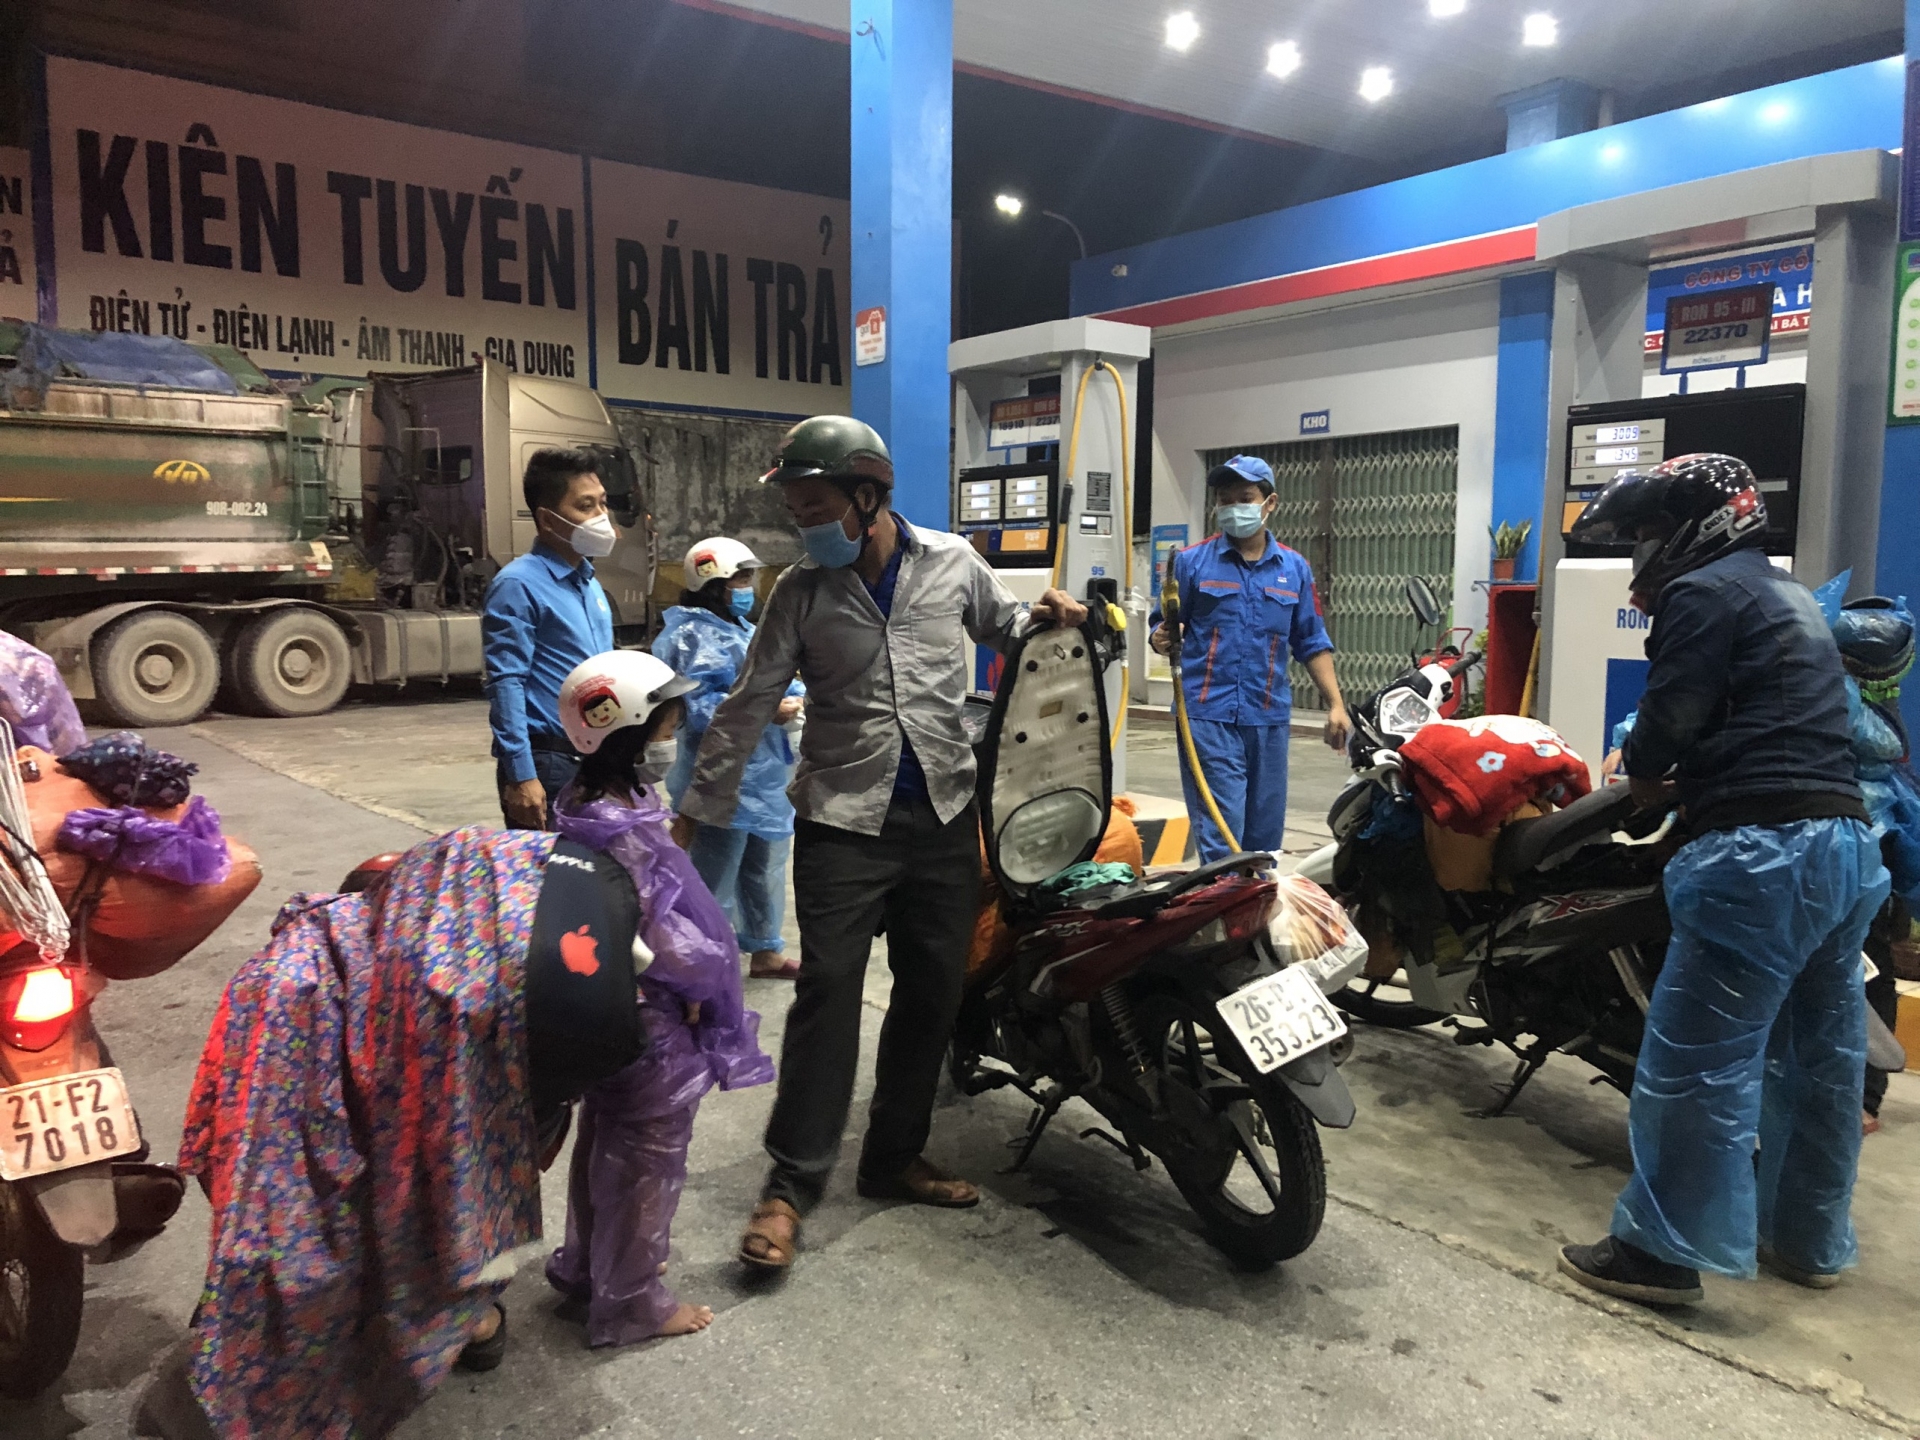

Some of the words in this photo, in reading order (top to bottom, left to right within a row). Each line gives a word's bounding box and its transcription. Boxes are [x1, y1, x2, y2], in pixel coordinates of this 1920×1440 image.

[77, 122, 300, 278] KIÊN
[327, 167, 576, 310] TUYẾN
[1684, 265, 1742, 288] CÔNG
[1747, 259, 1774, 278] TY
[615, 219, 730, 375] BÁN
[746, 215, 842, 386] TRẢ
[1681, 303, 1708, 322] RON
[1713, 300, 1730, 317] 95
[158, 287, 191, 340] TỬ
[213, 303, 269, 356] ĐIỆN
[276, 315, 335, 362] LẠNH
[357, 316, 391, 362] ÂM
[398, 328, 465, 367] THANH
[1683, 323, 1748, 344] 22370
[1036, 414, 1061, 426] 2237
[1303, 415, 1328, 429] KHO
[1612, 426, 1639, 440] 3009
[1091, 566, 1105, 576] 95
[1616, 608, 1649, 629] RON
[1250, 1004, 1336, 1065] 353.23
[7, 1079, 109, 1130] 21-F2
[15, 1116, 118, 1169] 7018
